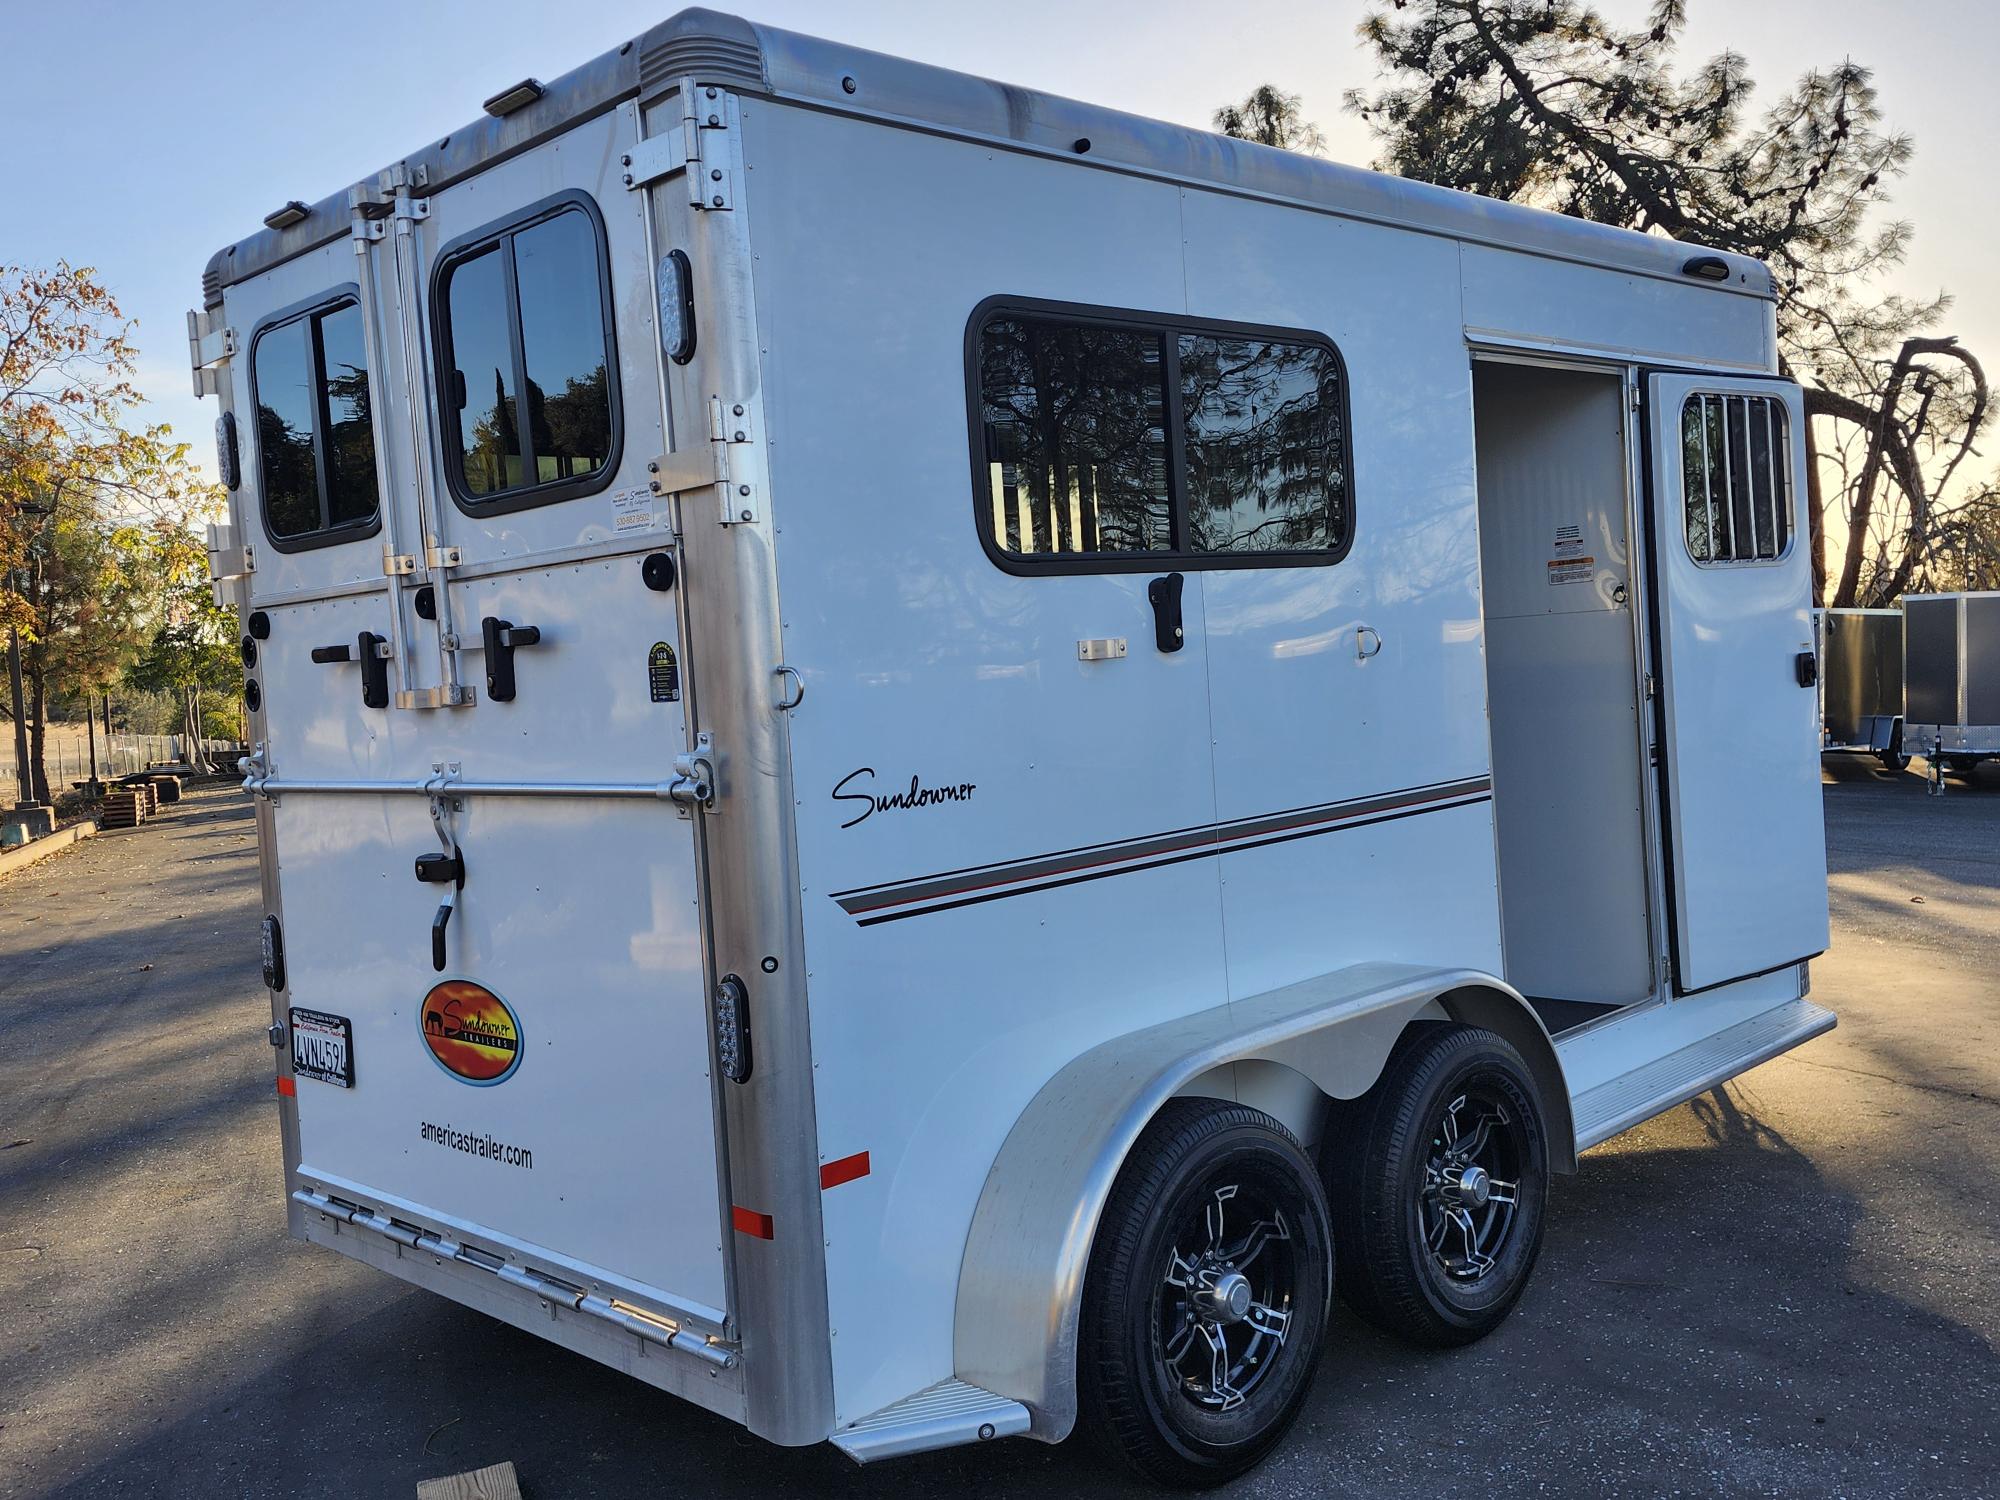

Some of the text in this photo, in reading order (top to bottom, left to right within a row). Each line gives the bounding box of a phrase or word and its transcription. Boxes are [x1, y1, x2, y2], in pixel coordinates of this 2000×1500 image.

[831, 767, 976, 829] Sundowner
[443, 999, 510, 1037] Sundowner
[463, 1032, 508, 1048] TRAILERS
[421, 1121, 533, 1169] americastrailer.com
